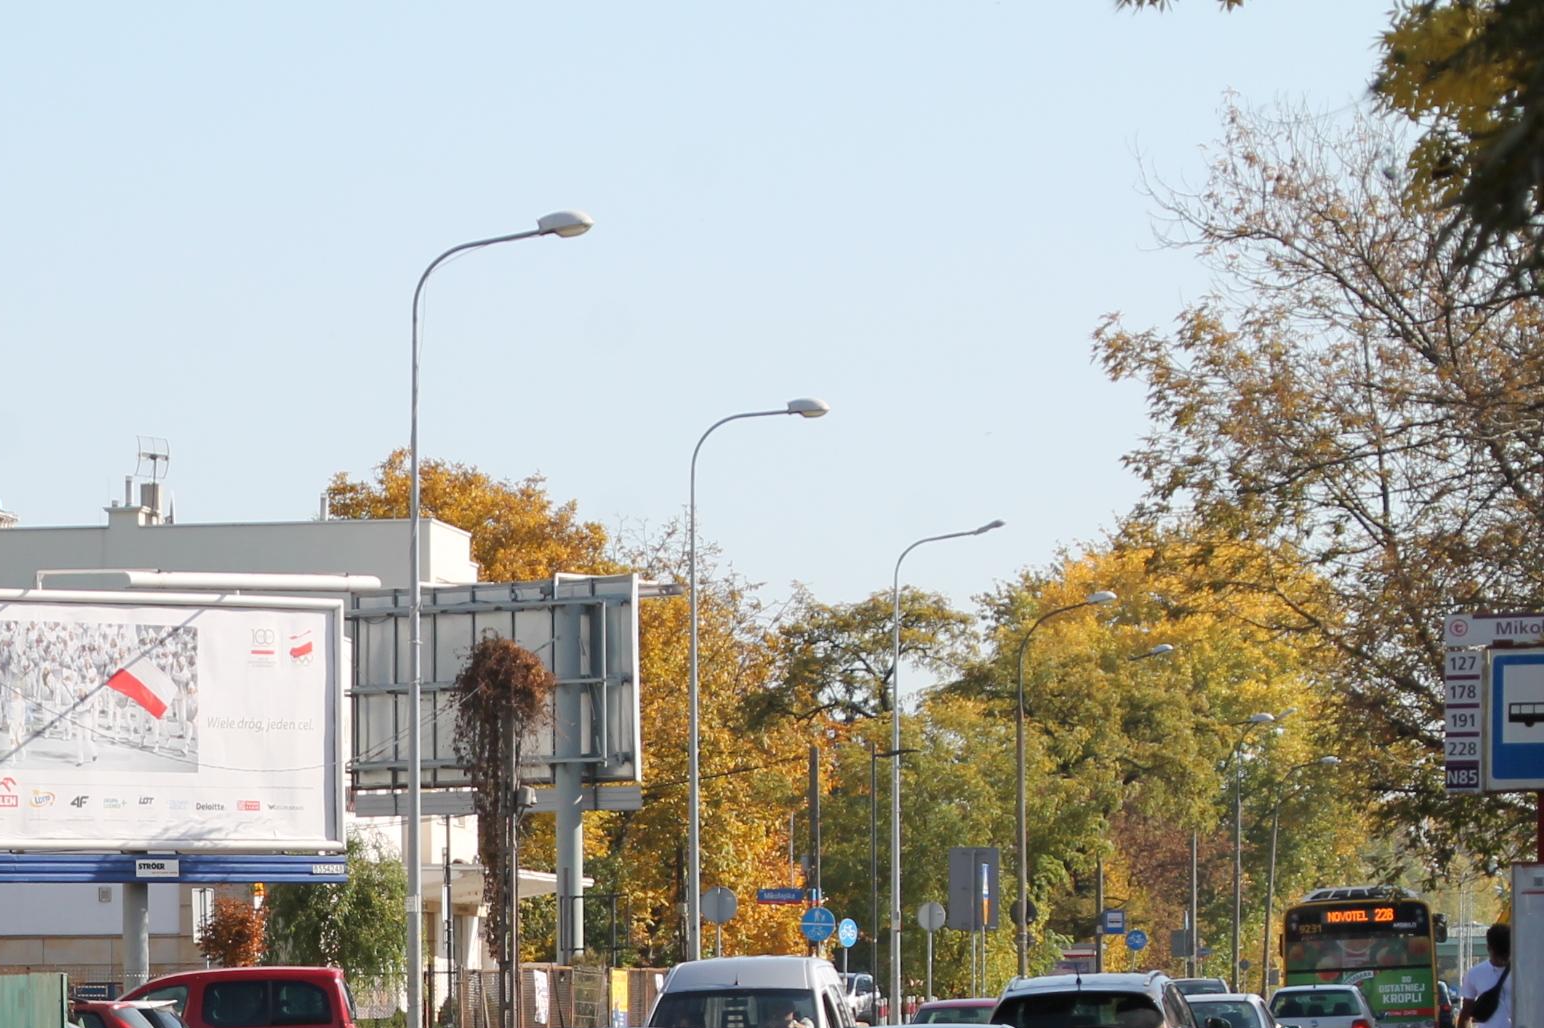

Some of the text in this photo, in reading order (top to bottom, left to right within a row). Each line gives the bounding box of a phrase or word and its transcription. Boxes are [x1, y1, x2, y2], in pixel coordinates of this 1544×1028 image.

[1450, 656, 1477, 670] 127
[1450, 684, 1477, 699] 178
[207, 716, 236, 729] Wiele
[265, 717, 295, 733] jeden
[1451, 713, 1475, 728] 191
[1448, 742, 1477, 756] 228
[1447, 769, 1478, 785] N85
[70, 795, 89, 808] 4F
[138, 796, 154, 805] LOT
[1327, 910, 1368, 923] NOVOTEL
[1379, 983, 1425, 993] OSTATNIEJ
[1383, 993, 1422, 1004] KROPLI
